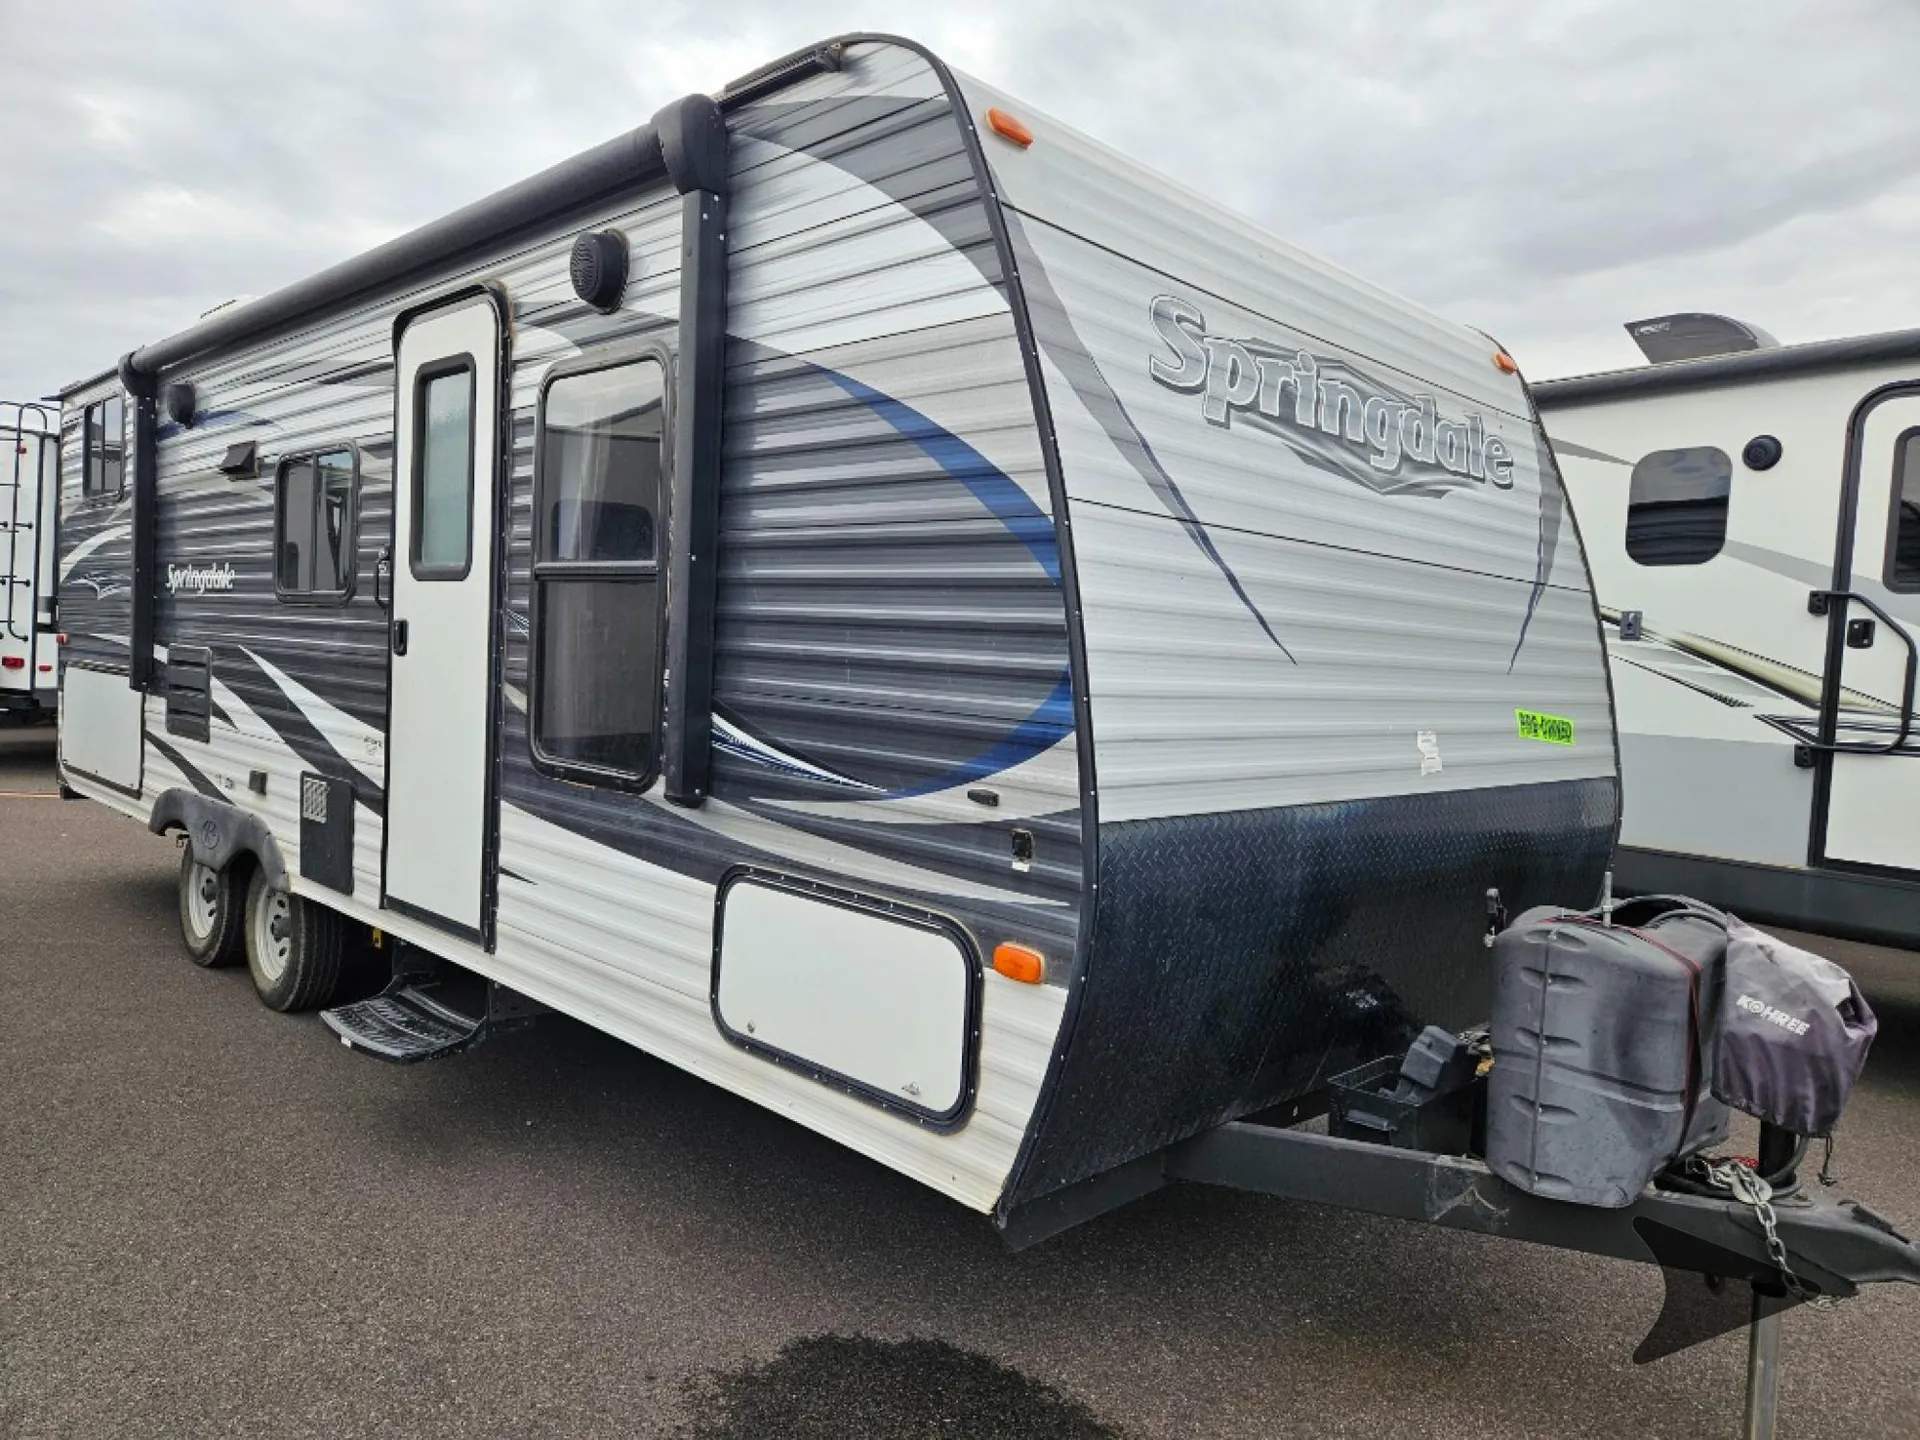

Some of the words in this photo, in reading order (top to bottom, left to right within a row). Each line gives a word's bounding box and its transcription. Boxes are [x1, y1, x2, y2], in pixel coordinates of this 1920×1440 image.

[1149, 294, 1514, 489] Springdale
[165, 562, 235, 595] Springdale
[1736, 994, 1810, 1035] KOHREE
